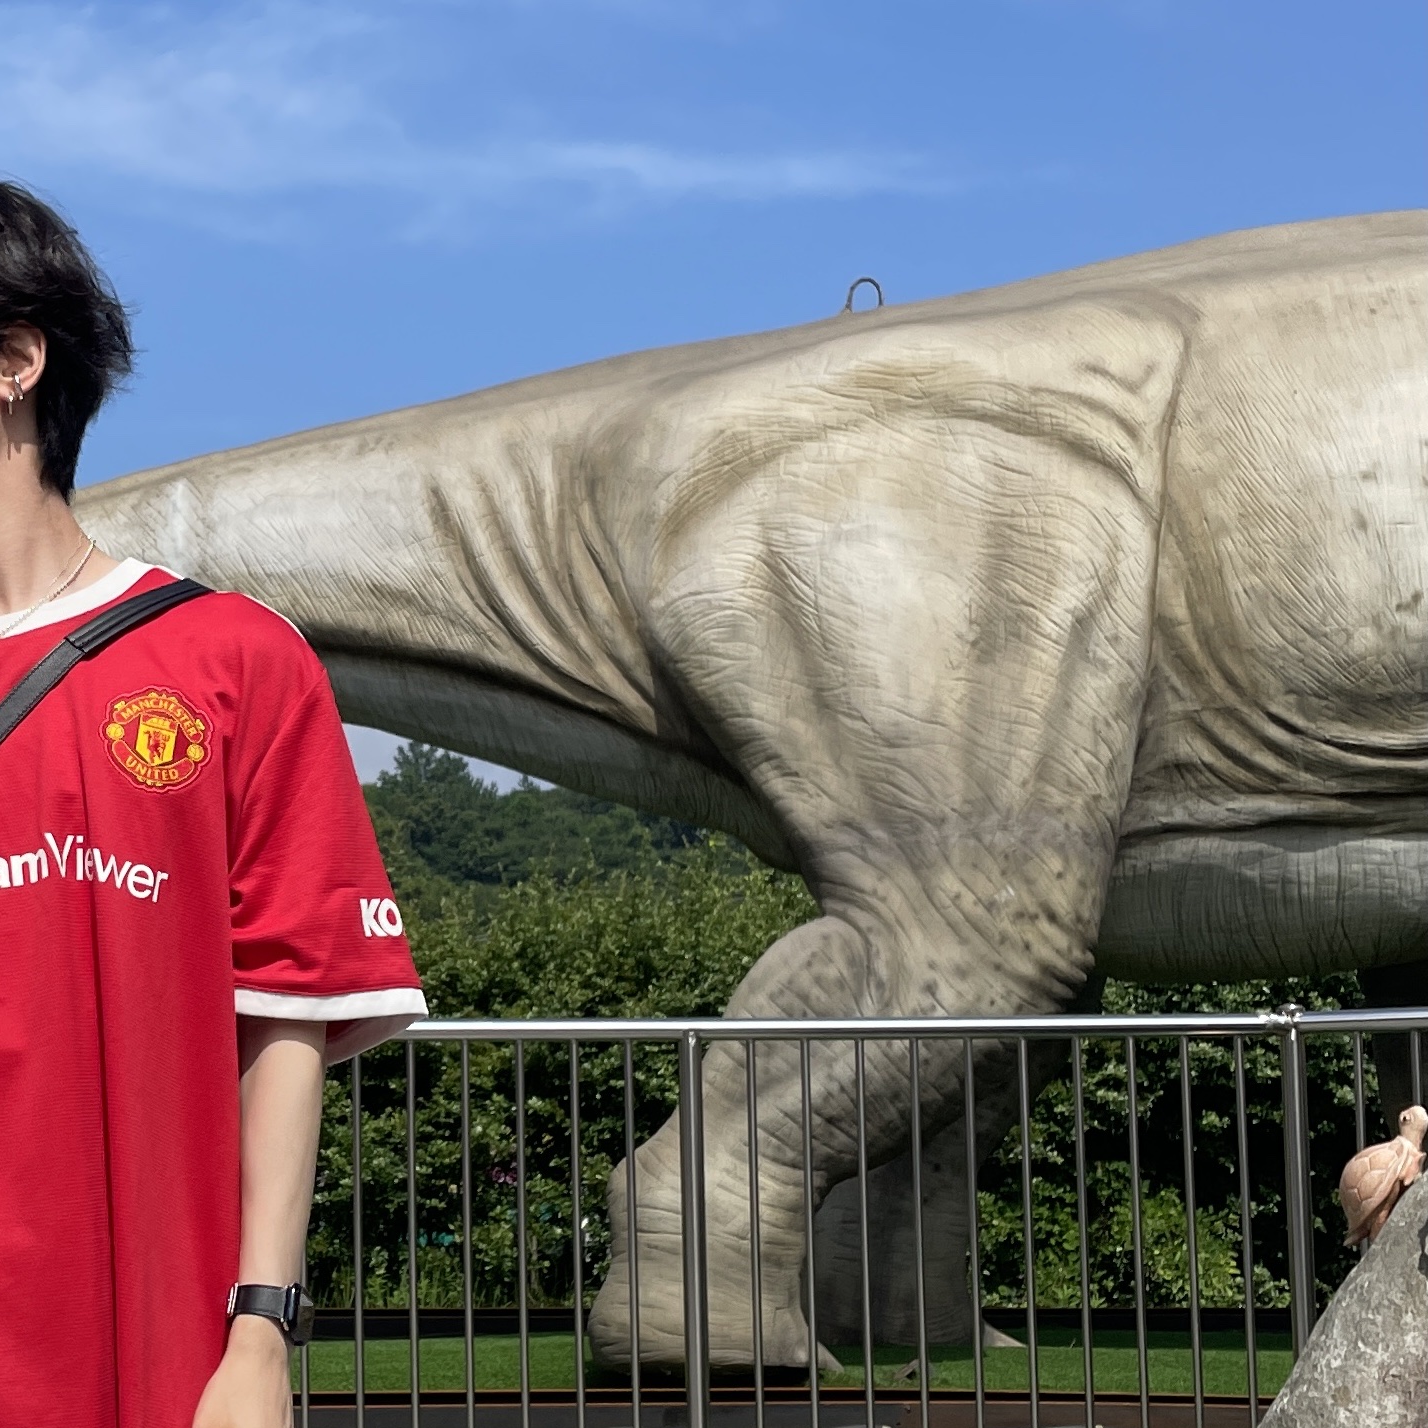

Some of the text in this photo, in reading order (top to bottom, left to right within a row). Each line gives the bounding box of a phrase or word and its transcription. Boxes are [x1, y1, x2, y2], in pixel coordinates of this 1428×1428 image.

[121, 698, 198, 737] MANCHESTER
[125, 755, 179, 781] UNITED
[360, 897, 404, 938] KO
